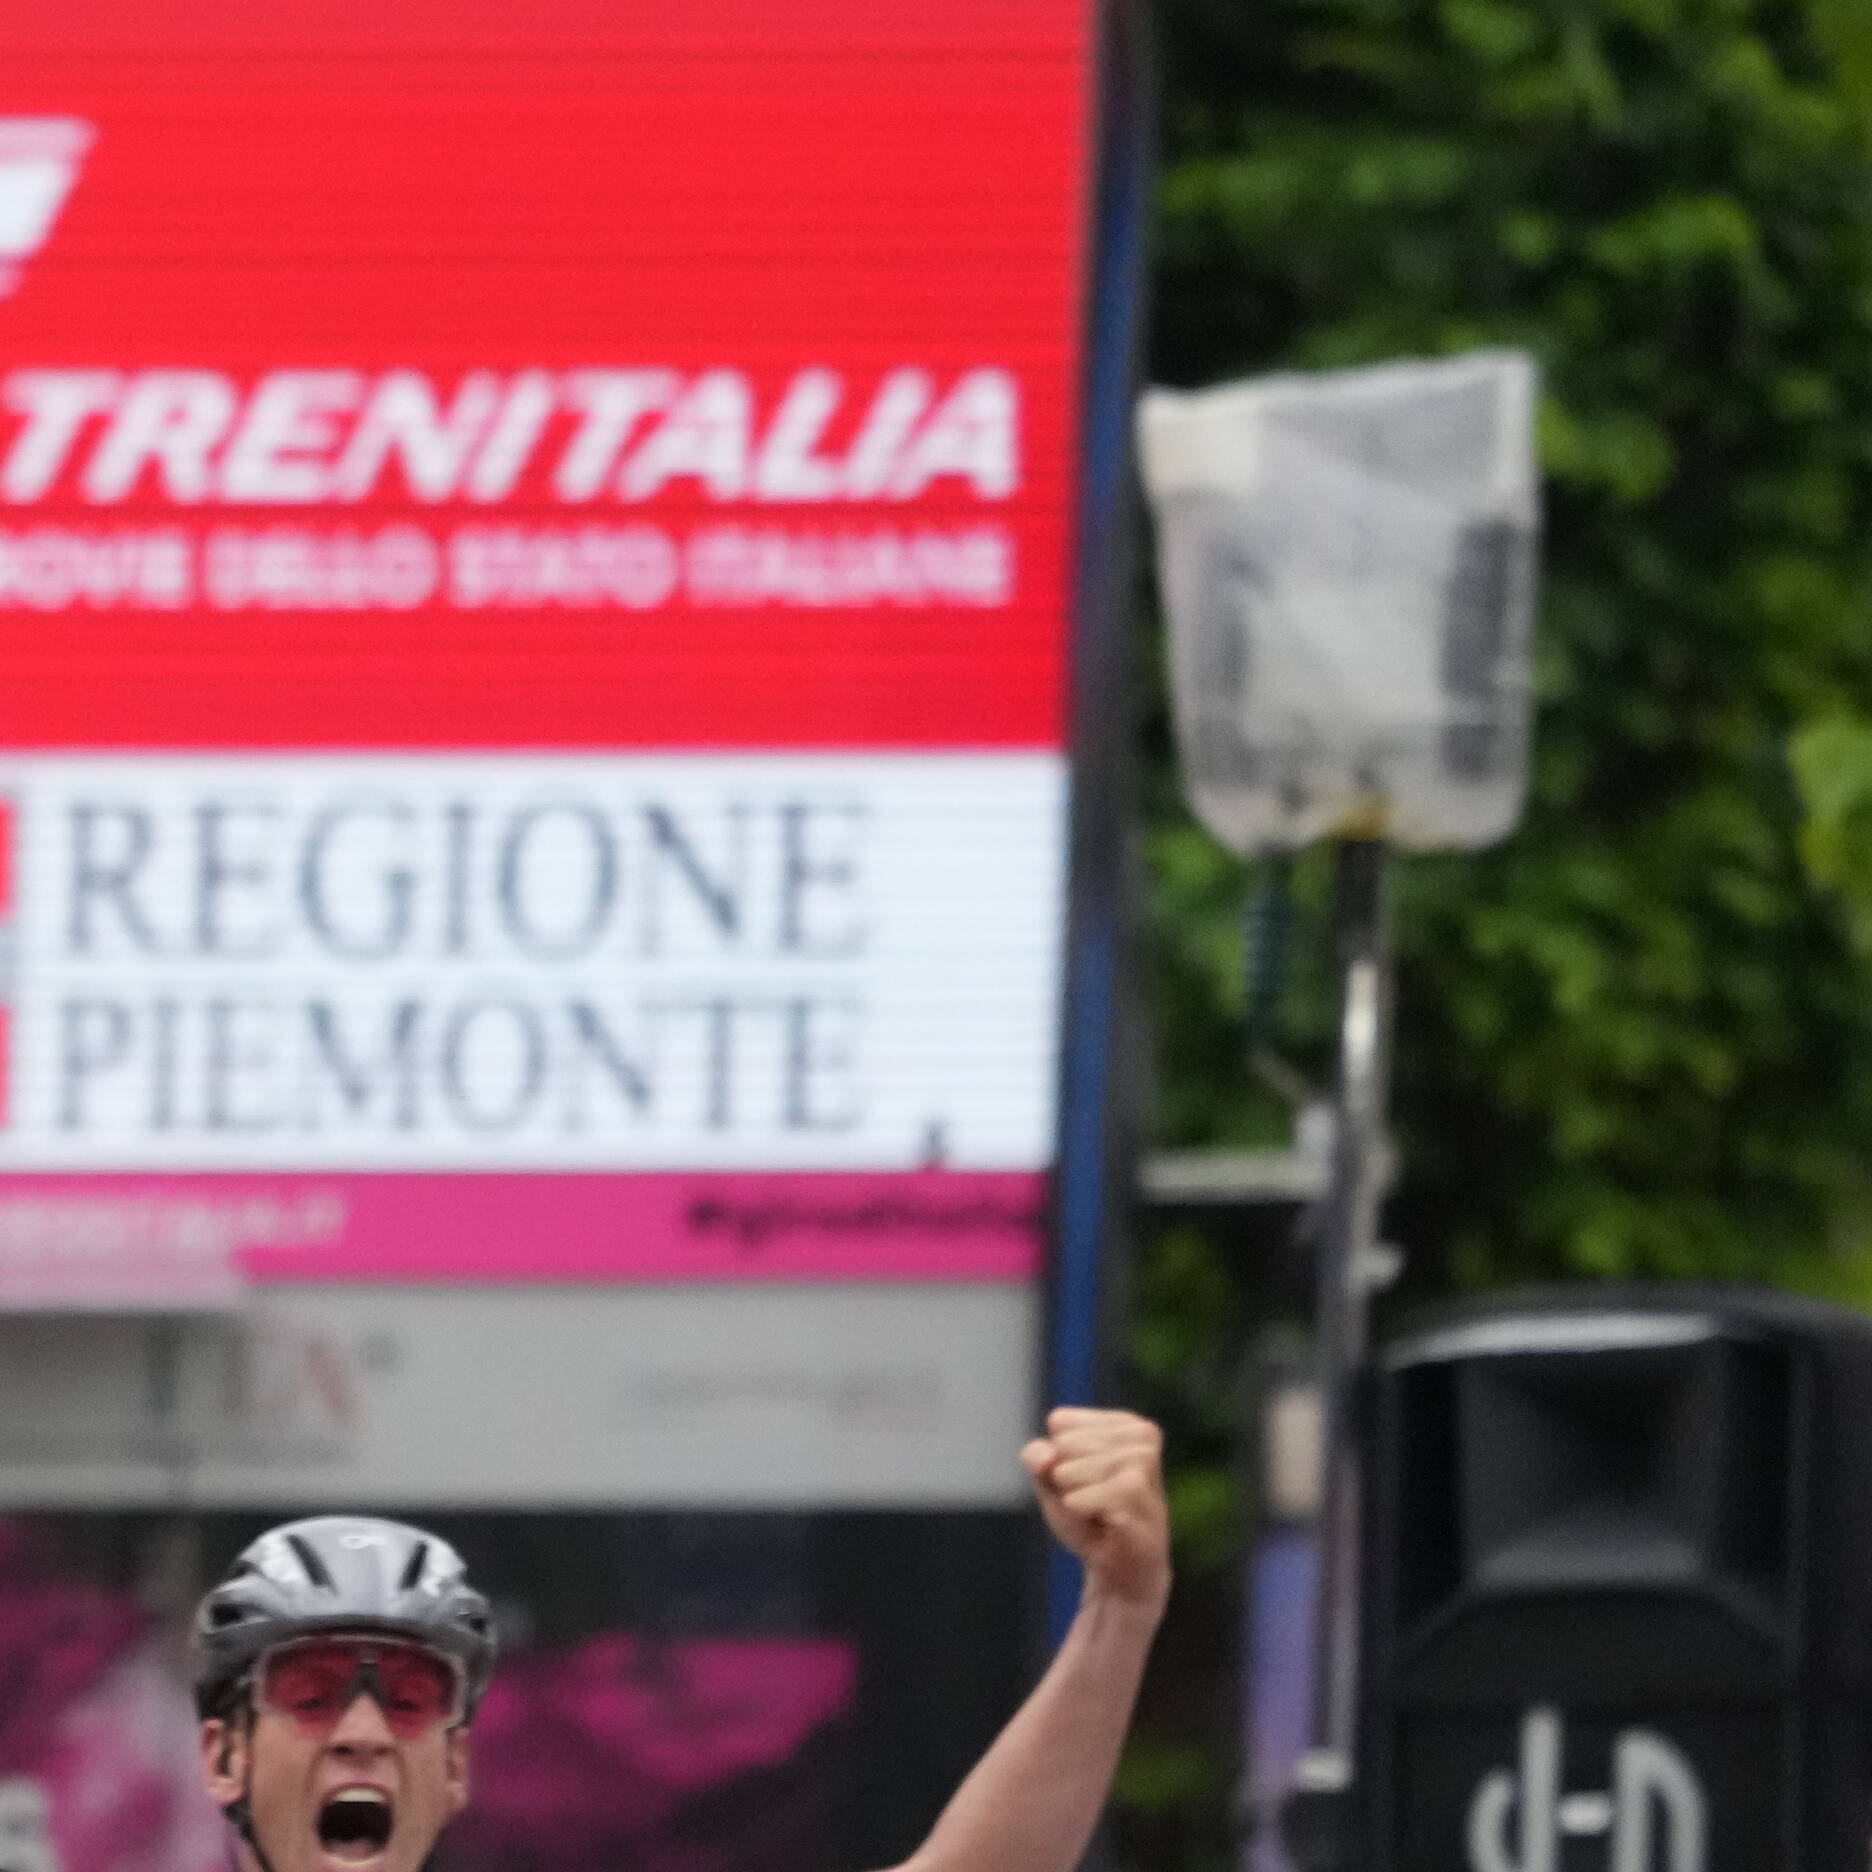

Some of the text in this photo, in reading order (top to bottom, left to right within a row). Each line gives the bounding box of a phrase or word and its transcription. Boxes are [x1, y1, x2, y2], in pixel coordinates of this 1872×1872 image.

[209, 526, 437, 608] DELLO
[451, 526, 668, 608] STATO
[684, 526, 1014, 608] ITALIANE
[59, 790, 875, 964] REGIONE
[55, 996, 868, 1135] PIEMONTE
